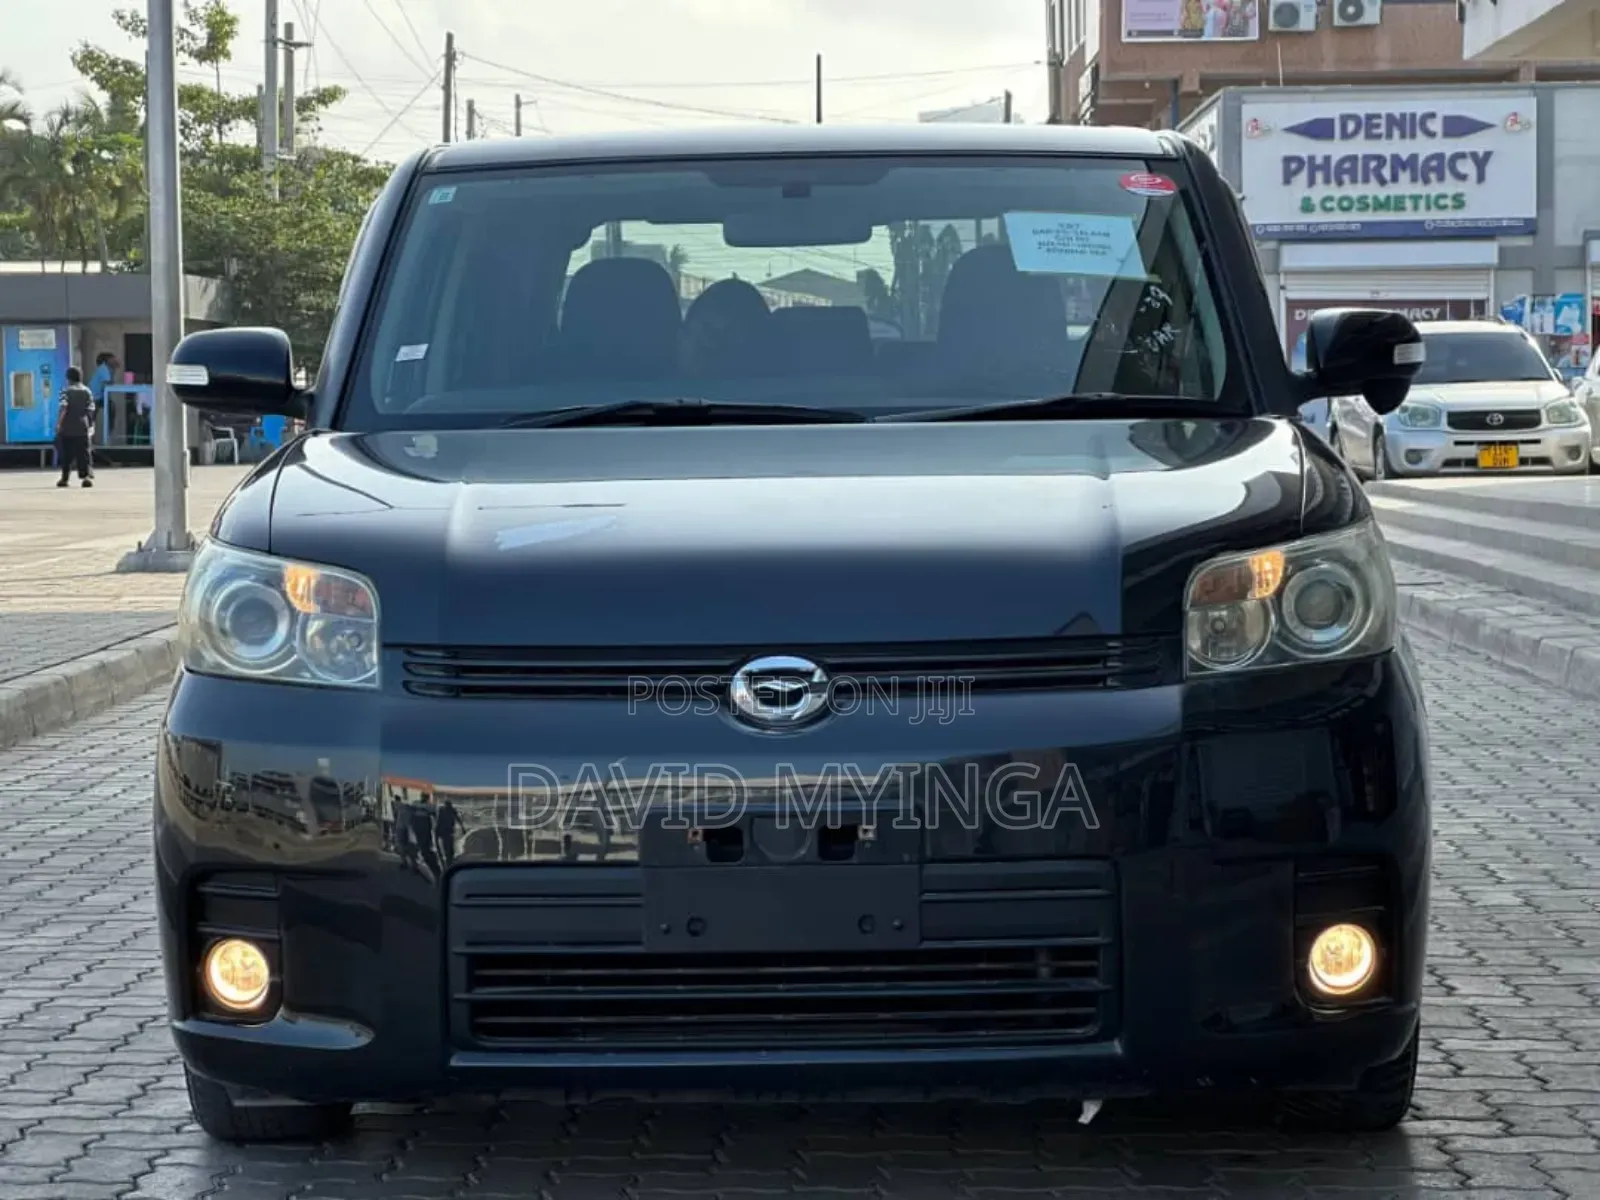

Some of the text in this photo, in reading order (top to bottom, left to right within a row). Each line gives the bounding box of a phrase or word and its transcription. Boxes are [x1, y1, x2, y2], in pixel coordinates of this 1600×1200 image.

[1338, 111, 1438, 141] DENIC
[1281, 150, 1494, 188] PHARMACY
[1320, 192, 1467, 213] COSMETICS
